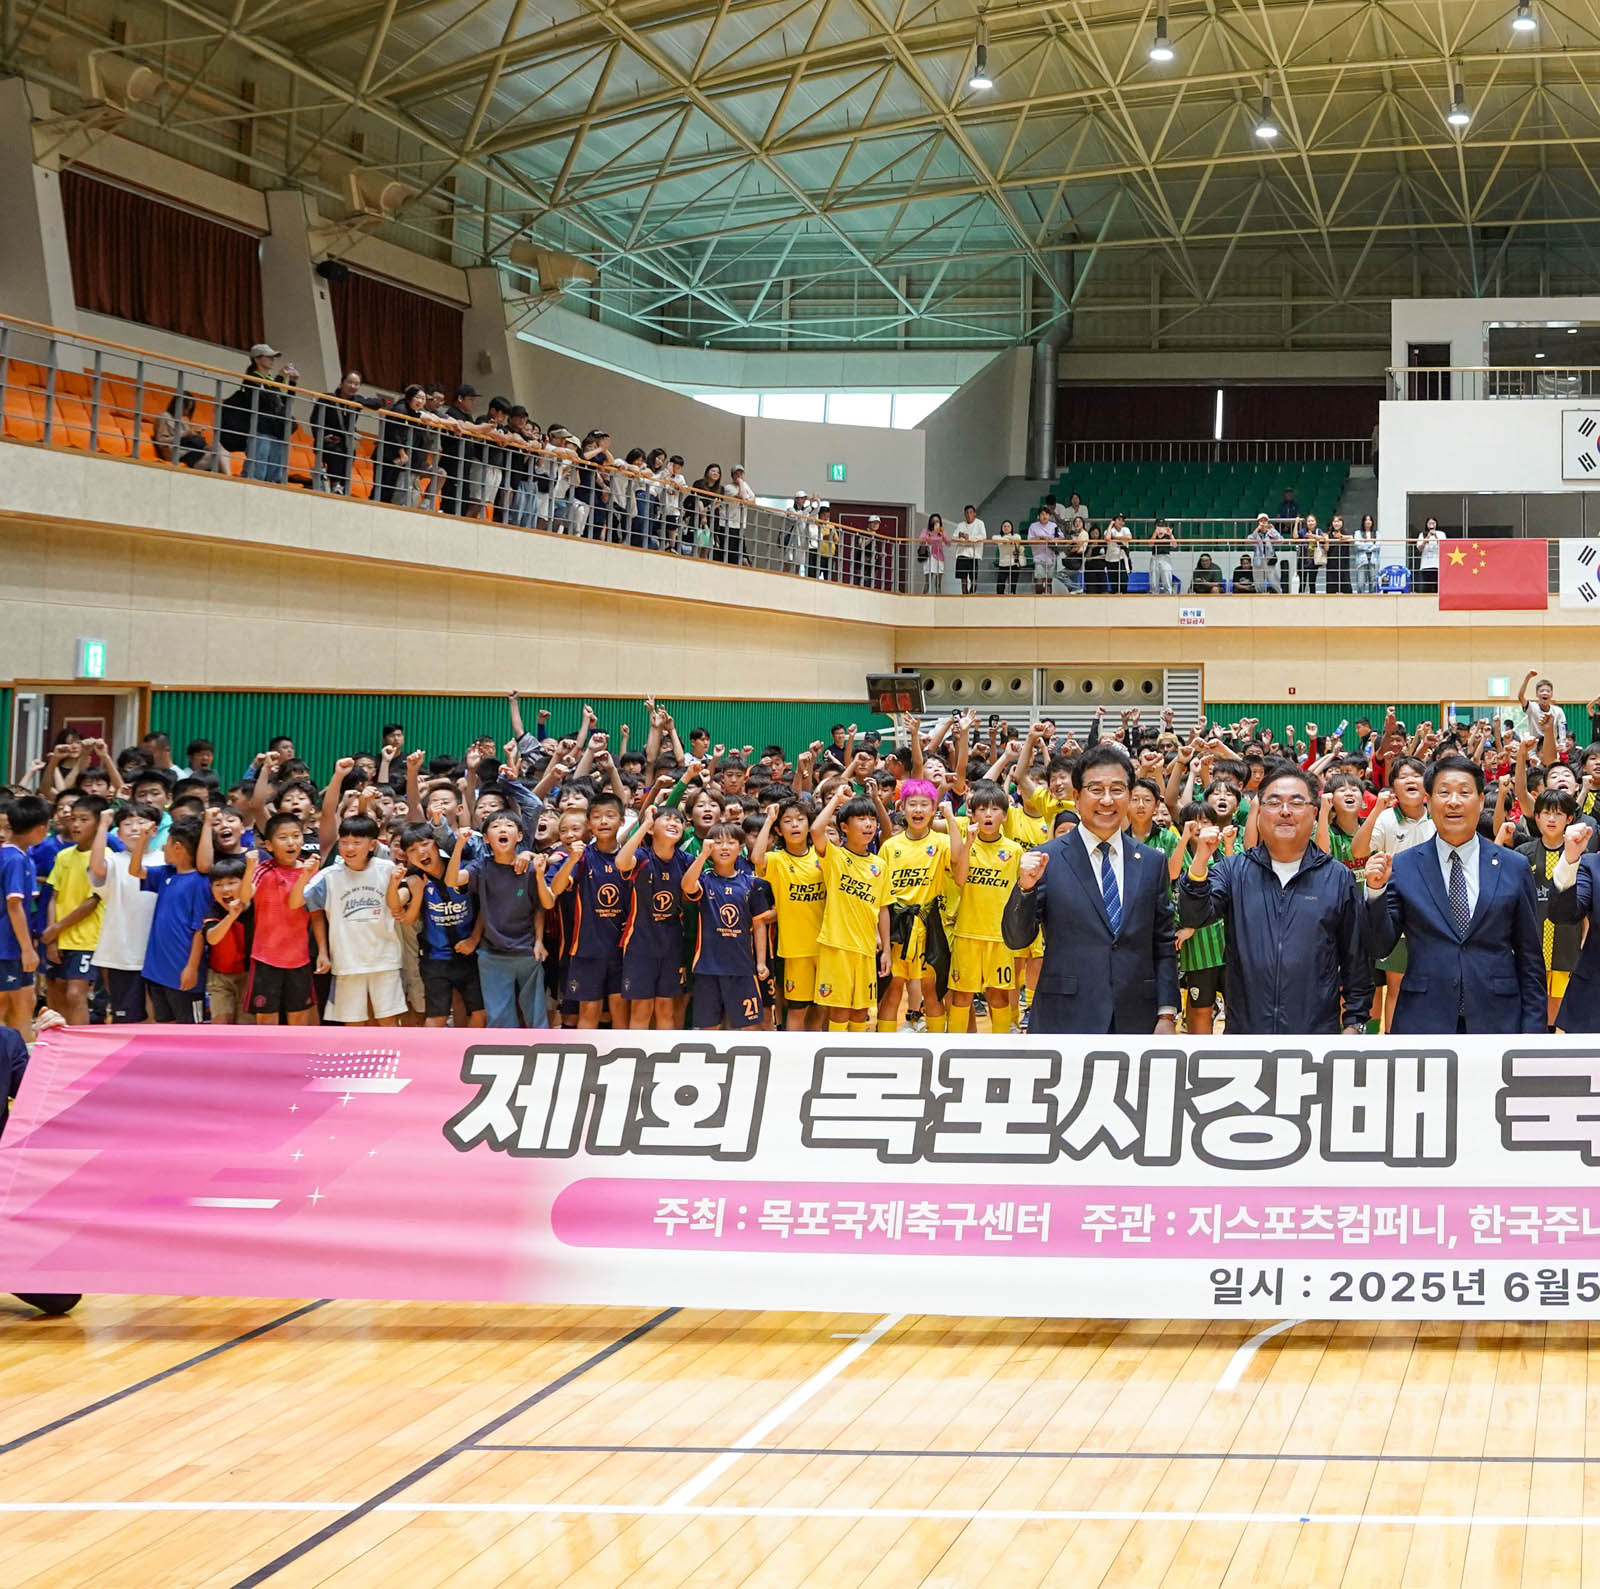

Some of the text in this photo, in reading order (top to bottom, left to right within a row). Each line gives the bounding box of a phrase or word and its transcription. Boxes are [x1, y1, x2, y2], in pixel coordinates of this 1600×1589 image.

[604, 864, 613, 873] 16
[662, 872, 670, 880] 20
[891, 868, 930, 879] FIRST
[725, 886, 733, 895] 21
[789, 882, 824, 892] FIRST
[840, 874, 872, 892] FIRST
[892, 876, 932, 888] SEARC
[966, 876, 1009, 888] SEARCH
[838, 883, 876, 904] SEARCH
[79, 954, 91, 973] 5
[996, 966, 1012, 984] 10
[742, 996, 759, 1016] 21
[443, 1044, 771, 1161] 제1회
[800, 1047, 1458, 1170] 목포시장배
[653, 1196, 726, 1238] 주최
[758, 1199, 1051, 1243] 목포국제축구센터
[1080, 1203, 1155, 1243] 주관
[1188, 1203, 1458, 1249] 지스포츠컴퍼니,
[1209, 1266, 1285, 1307] 일시
[1328, 1267, 1487, 1306] 2025년
